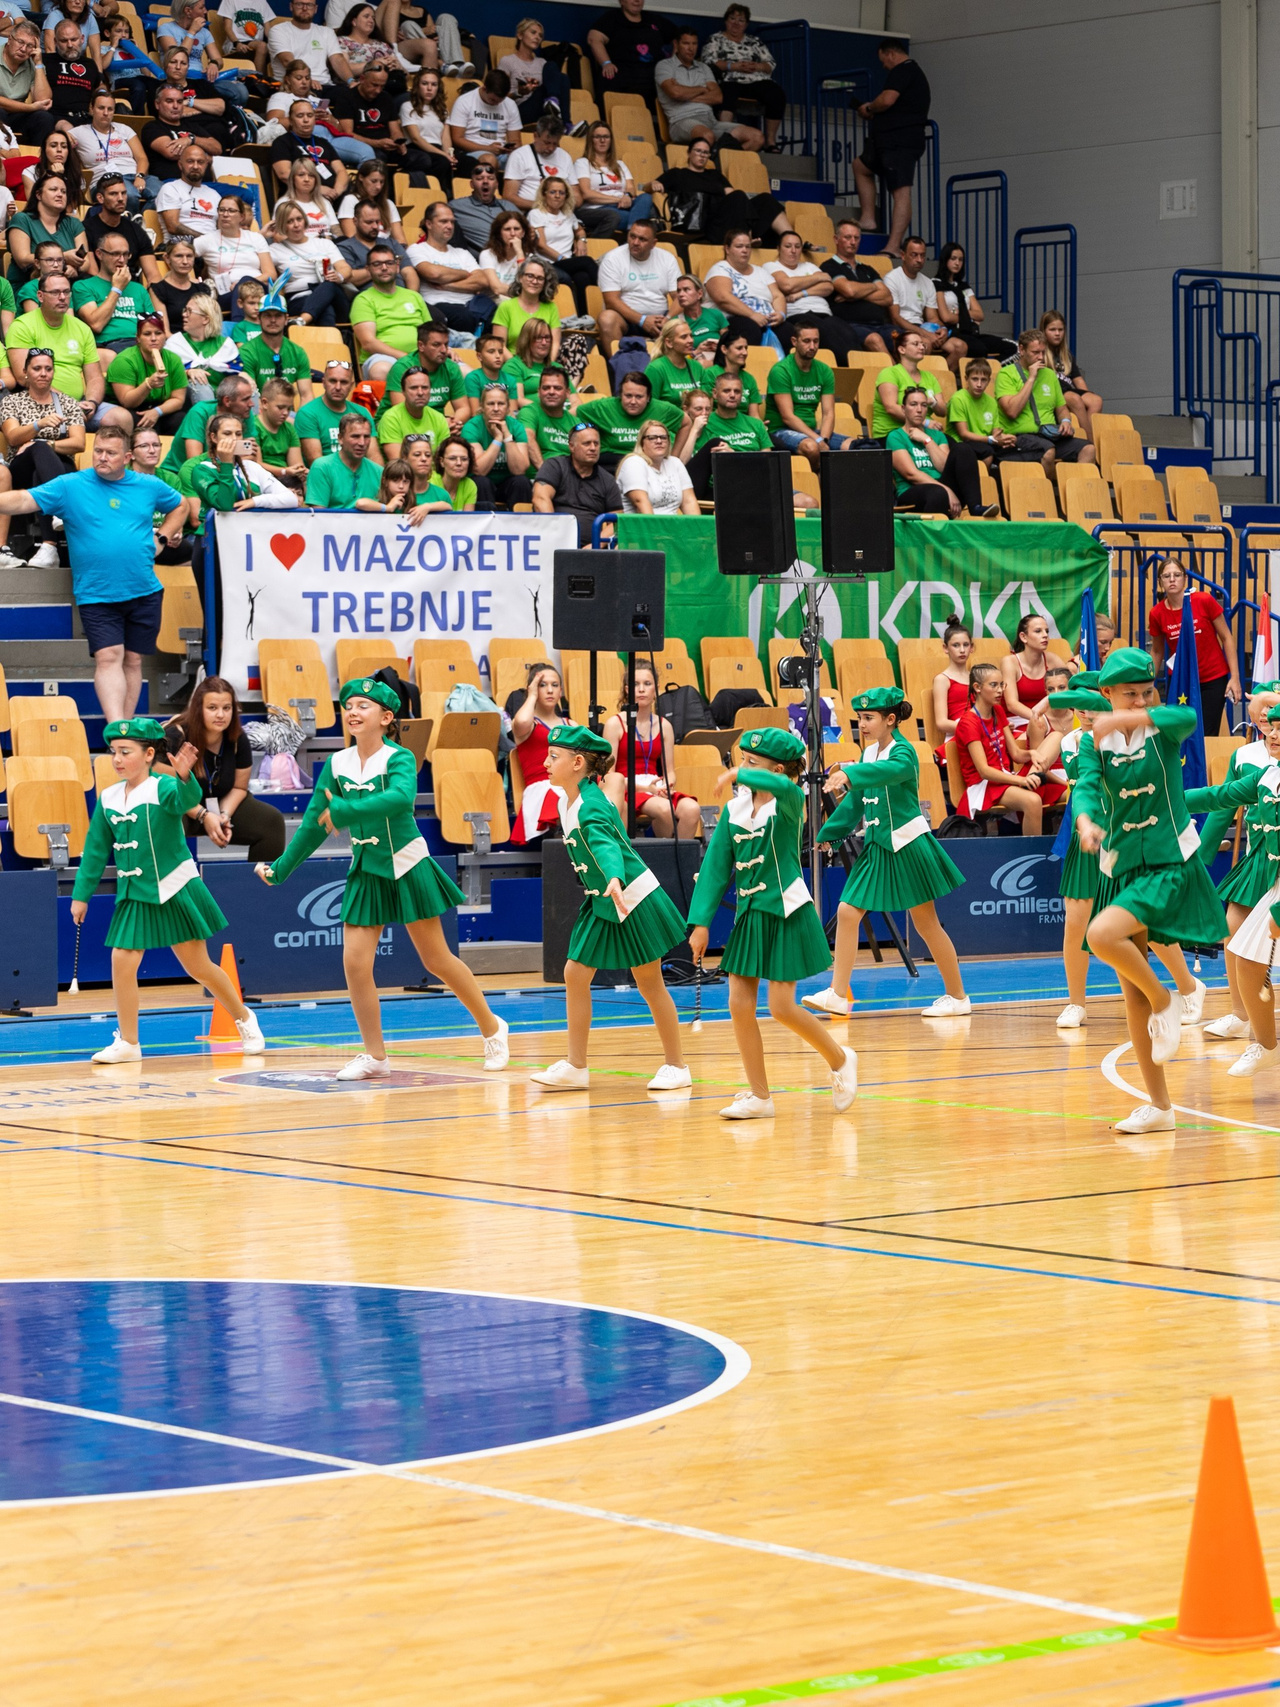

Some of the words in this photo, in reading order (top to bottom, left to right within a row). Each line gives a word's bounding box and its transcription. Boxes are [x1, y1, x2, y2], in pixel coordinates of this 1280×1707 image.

[59, 62, 69, 75] I
[245, 533, 253, 572] I
[322, 524, 542, 573] MAŽORETE
[302, 590, 493, 633] TREBNJE
[868, 580, 1063, 640] KRKA
[48, 684, 54, 692] 4
[1038, 914, 1066, 924] FRAN
